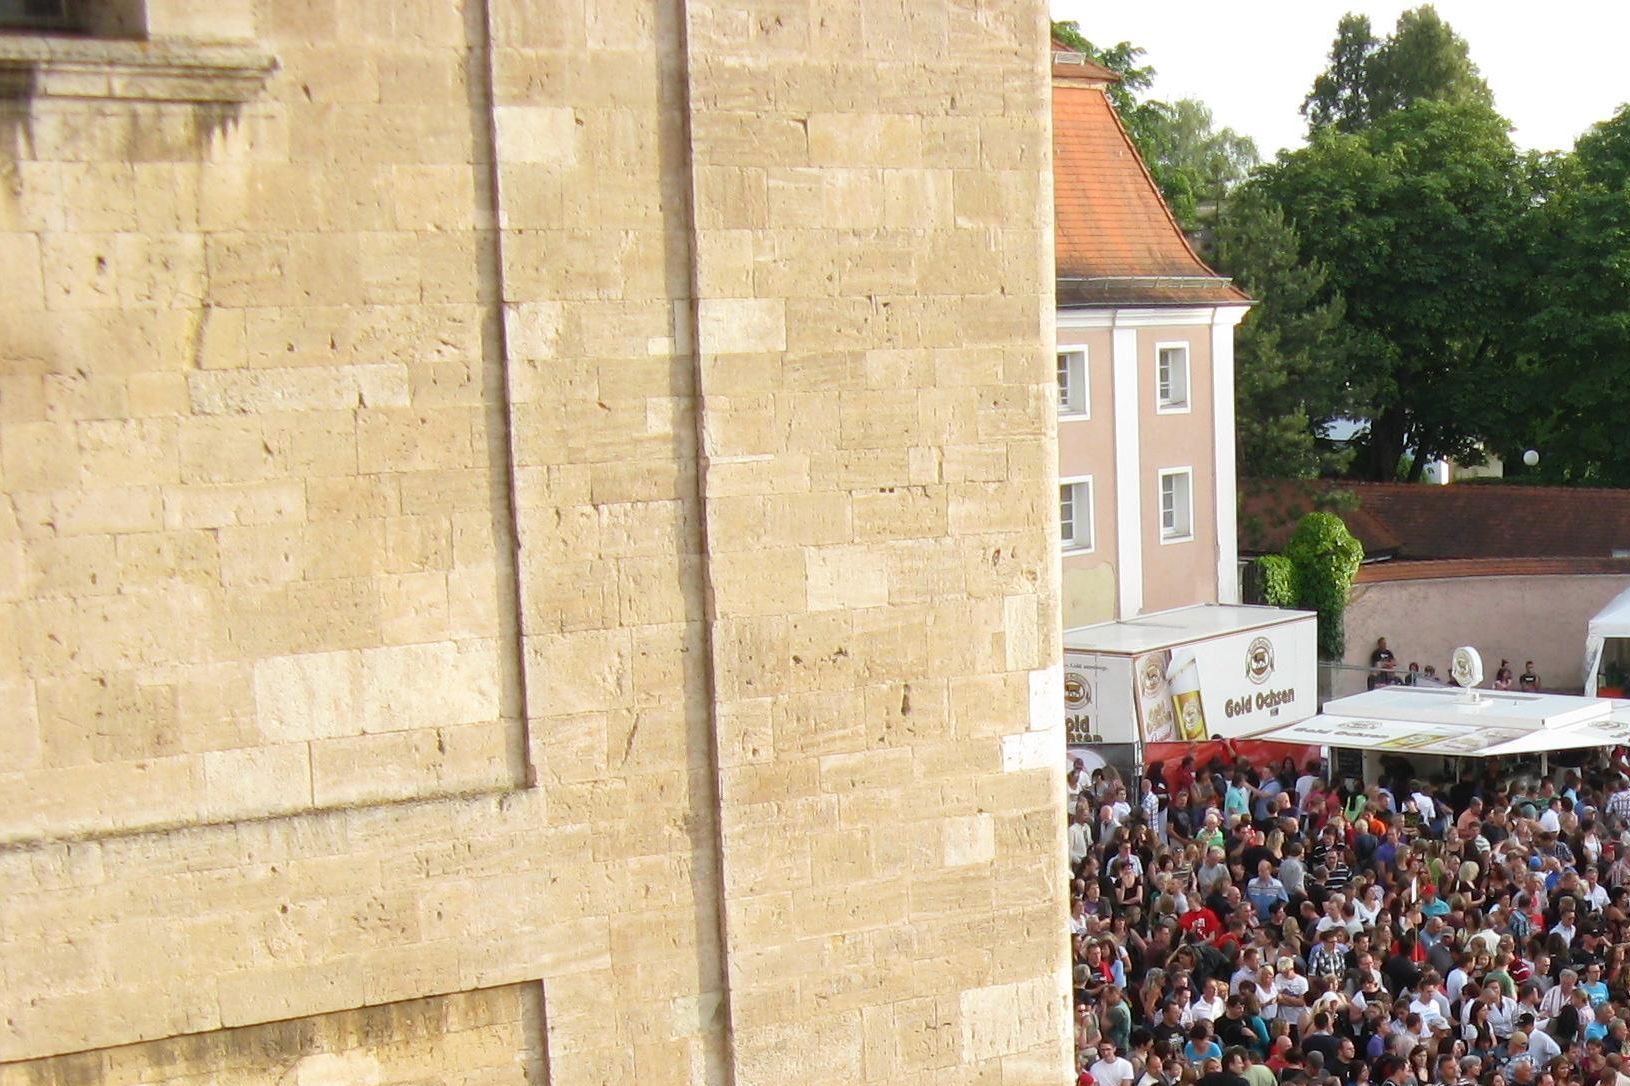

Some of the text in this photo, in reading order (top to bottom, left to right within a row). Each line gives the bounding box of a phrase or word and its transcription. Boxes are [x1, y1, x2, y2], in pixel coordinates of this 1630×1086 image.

[1224, 694, 1253, 719] Gold
[1255, 687, 1295, 711] Ochsen
[1065, 714, 1090, 734] old
